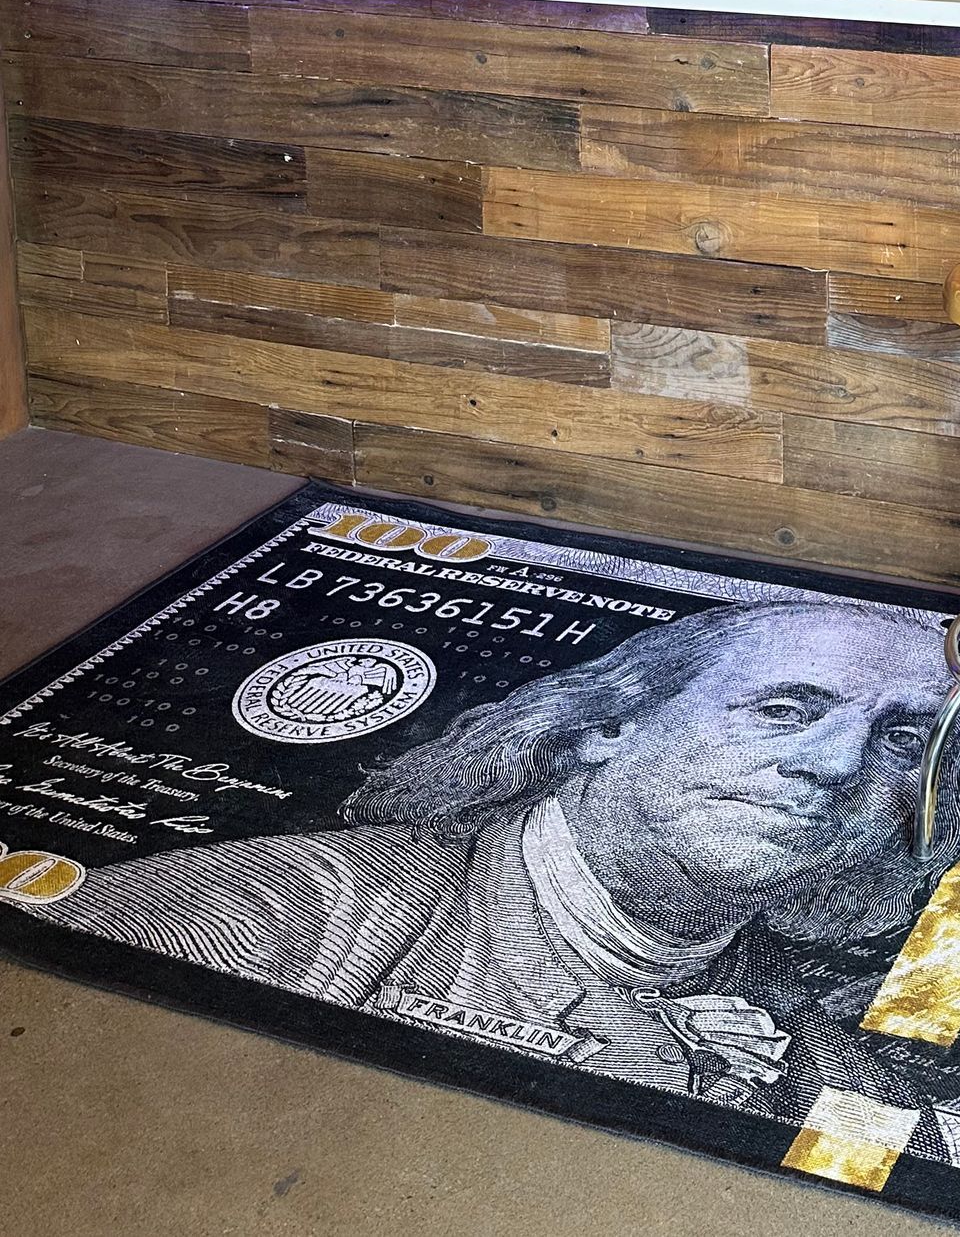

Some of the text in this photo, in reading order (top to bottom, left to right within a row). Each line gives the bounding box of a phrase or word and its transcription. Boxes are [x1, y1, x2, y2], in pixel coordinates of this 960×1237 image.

[308, 514, 495, 563] 100
[301, 542, 677, 621] FEDERAL RESERVE NOTE
[213, 591, 281, 619] H8
[307, 644, 425, 680] UNITED STATES
[246, 664, 418, 737] FEDERAL RESERVE SYSTEM
[44, 755, 102, 780] Secretary
[100, 771, 118, 784] of
[116, 771, 141, 787] the
[150, 754, 192, 772] The
[22, 804, 50, 820] the
[49, 811, 94, 835] United
[93, 823, 139, 844] States.
[406, 997, 563, 1050] FRANKLIN
